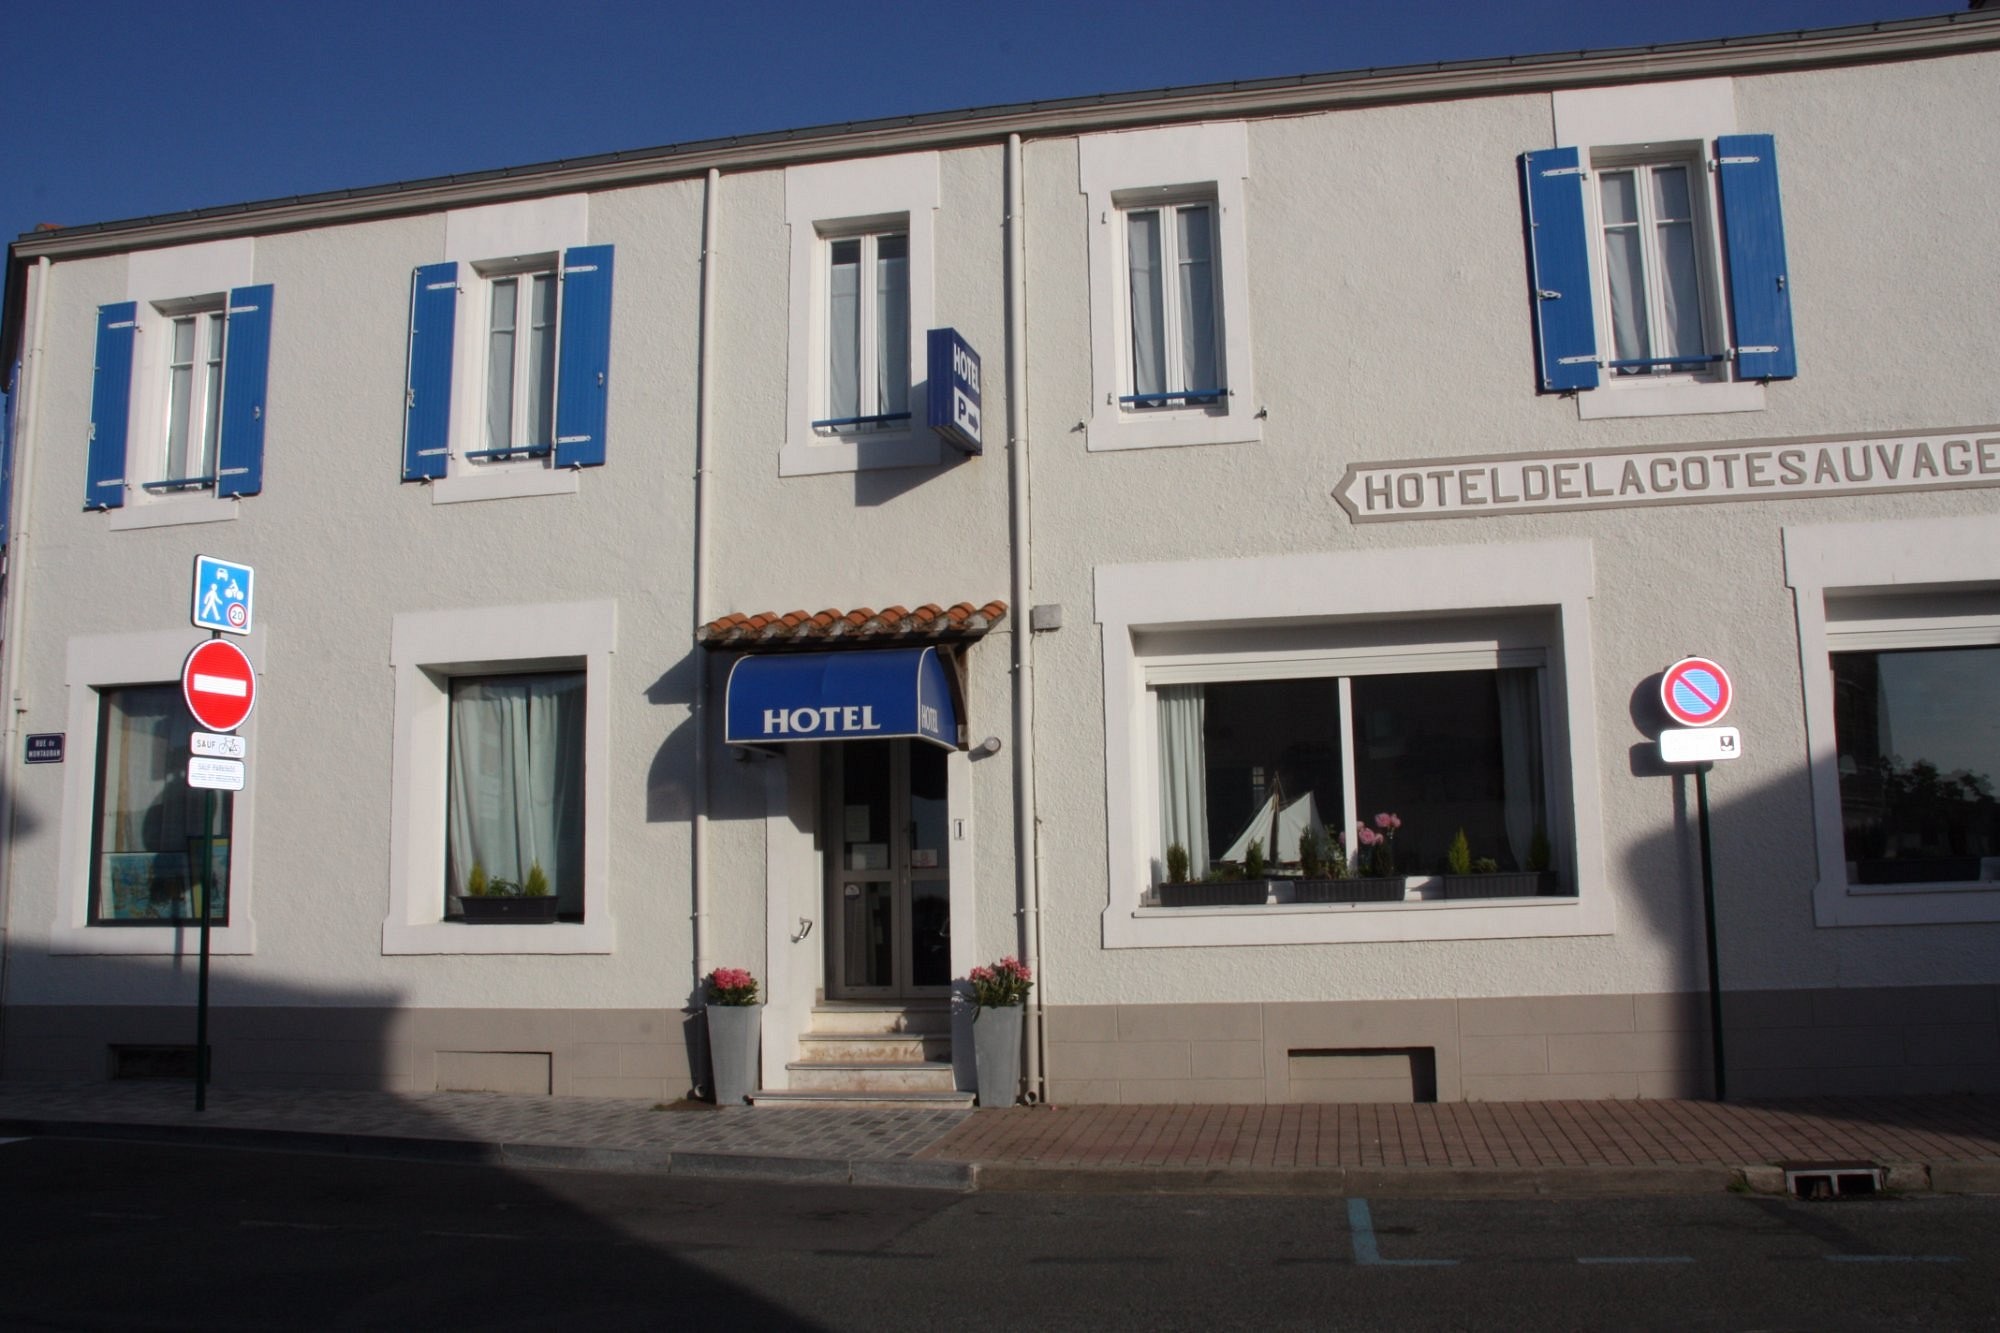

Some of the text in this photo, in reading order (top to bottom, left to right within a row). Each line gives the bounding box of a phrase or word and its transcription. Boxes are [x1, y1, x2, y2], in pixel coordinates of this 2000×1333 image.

[953, 343, 980, 395] HOTEL
[958, 396, 967, 420] P
[232, 610, 243, 621] 20
[763, 706, 881, 734] HOTEL
[921, 704, 939, 733] HOTEL
[196, 739, 216, 750] SAUF
